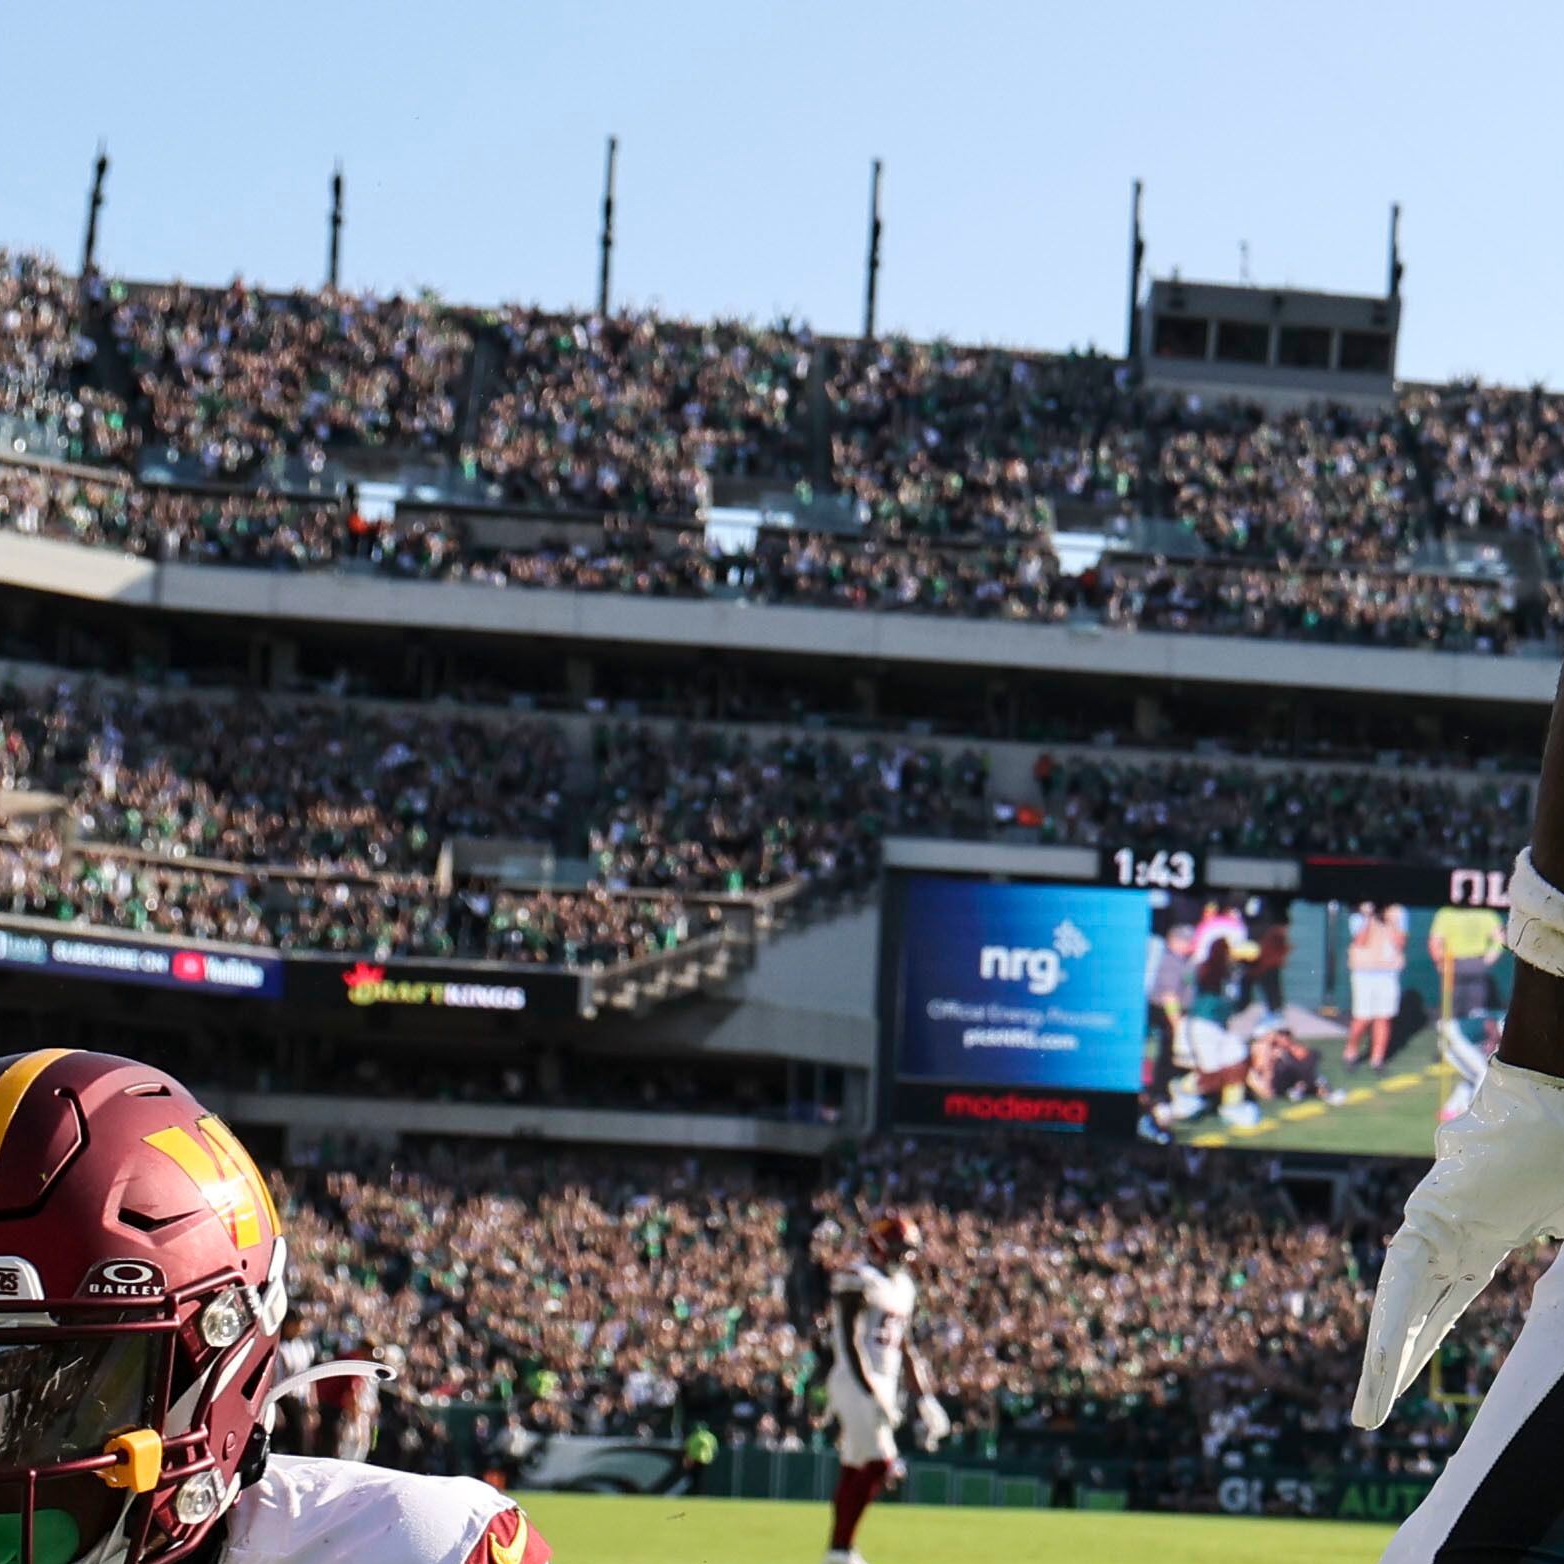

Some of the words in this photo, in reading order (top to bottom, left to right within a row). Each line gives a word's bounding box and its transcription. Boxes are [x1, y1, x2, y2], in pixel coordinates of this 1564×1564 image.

[1114, 847, 1195, 889] 1:43
[980, 945, 1061, 995] nrg
[943, 1091, 1091, 1123] moderna
[88, 1284, 163, 1296] OAKLEY
